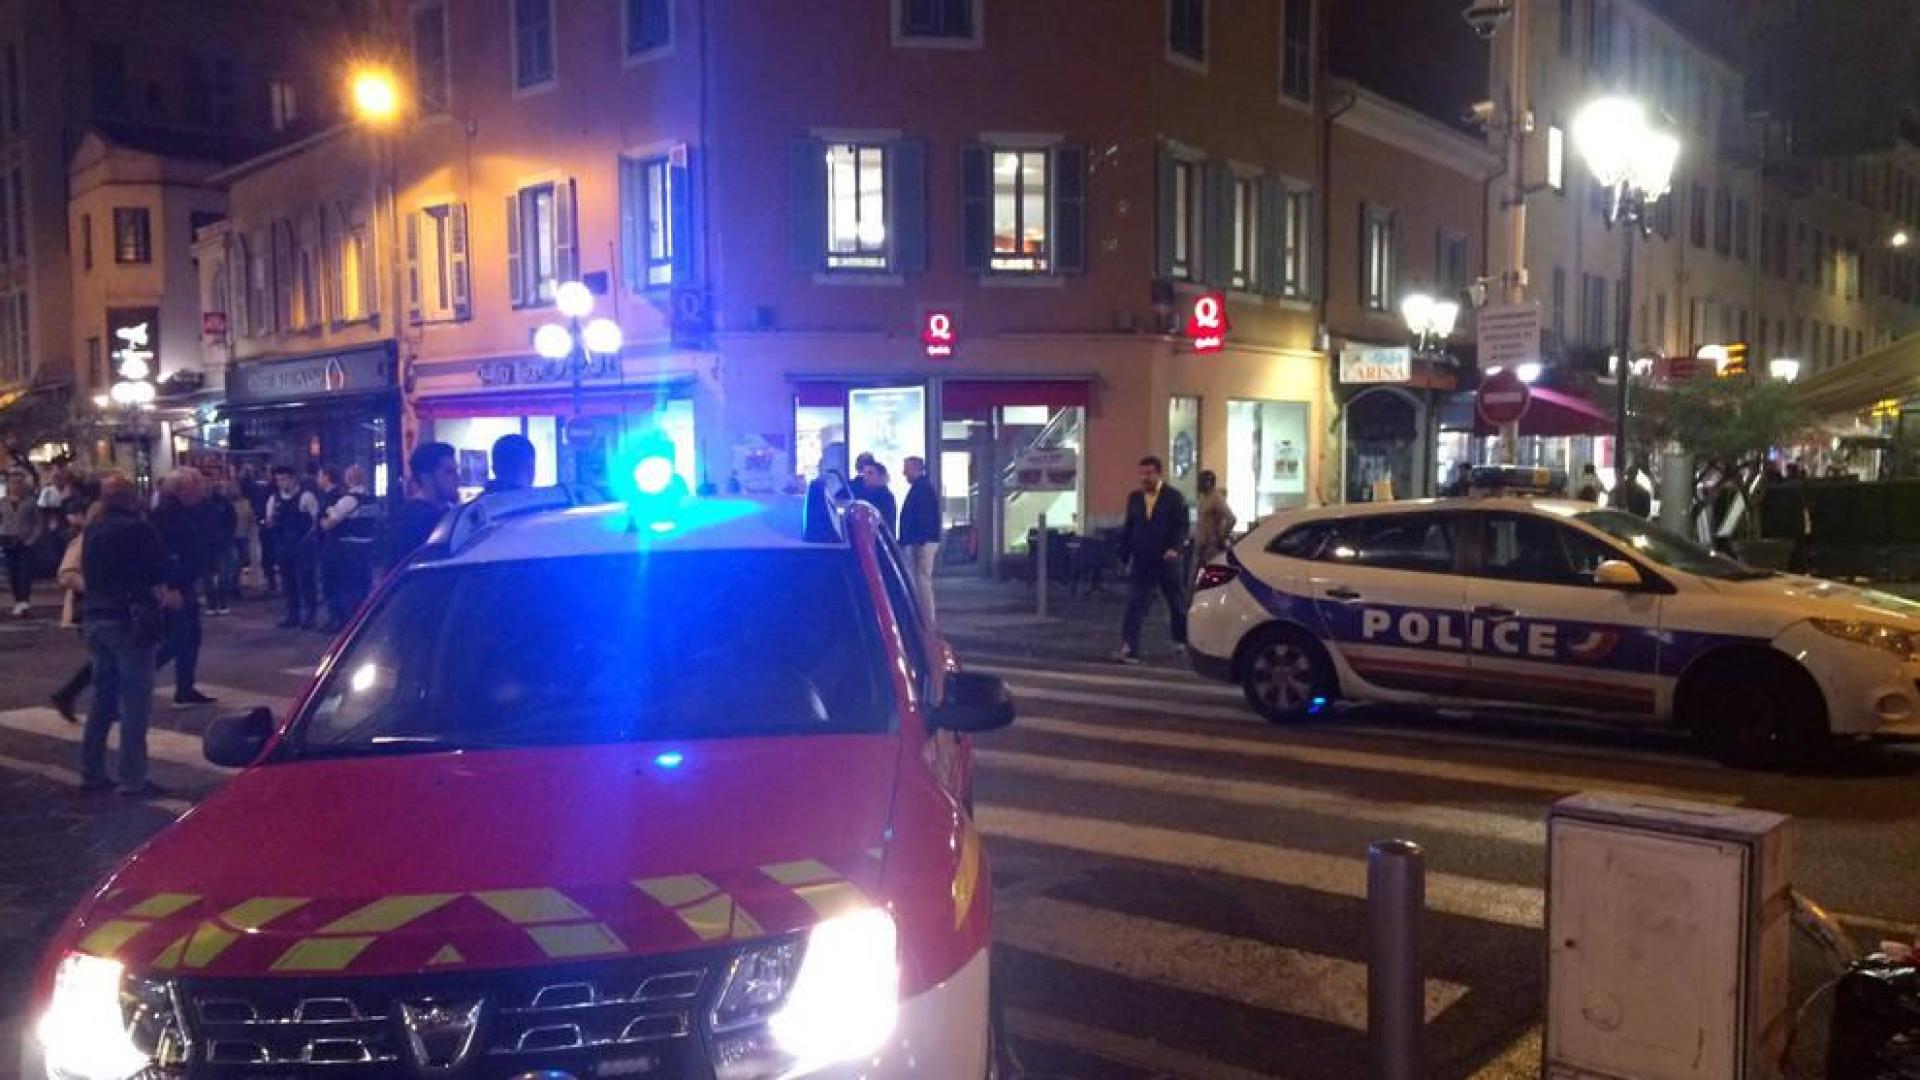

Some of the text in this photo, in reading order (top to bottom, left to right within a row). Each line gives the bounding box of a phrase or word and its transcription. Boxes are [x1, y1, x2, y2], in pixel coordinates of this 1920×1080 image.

[930, 313, 951, 340] Q
[1194, 297, 1220, 328] Q
[1362, 609, 1556, 657] POLICE
